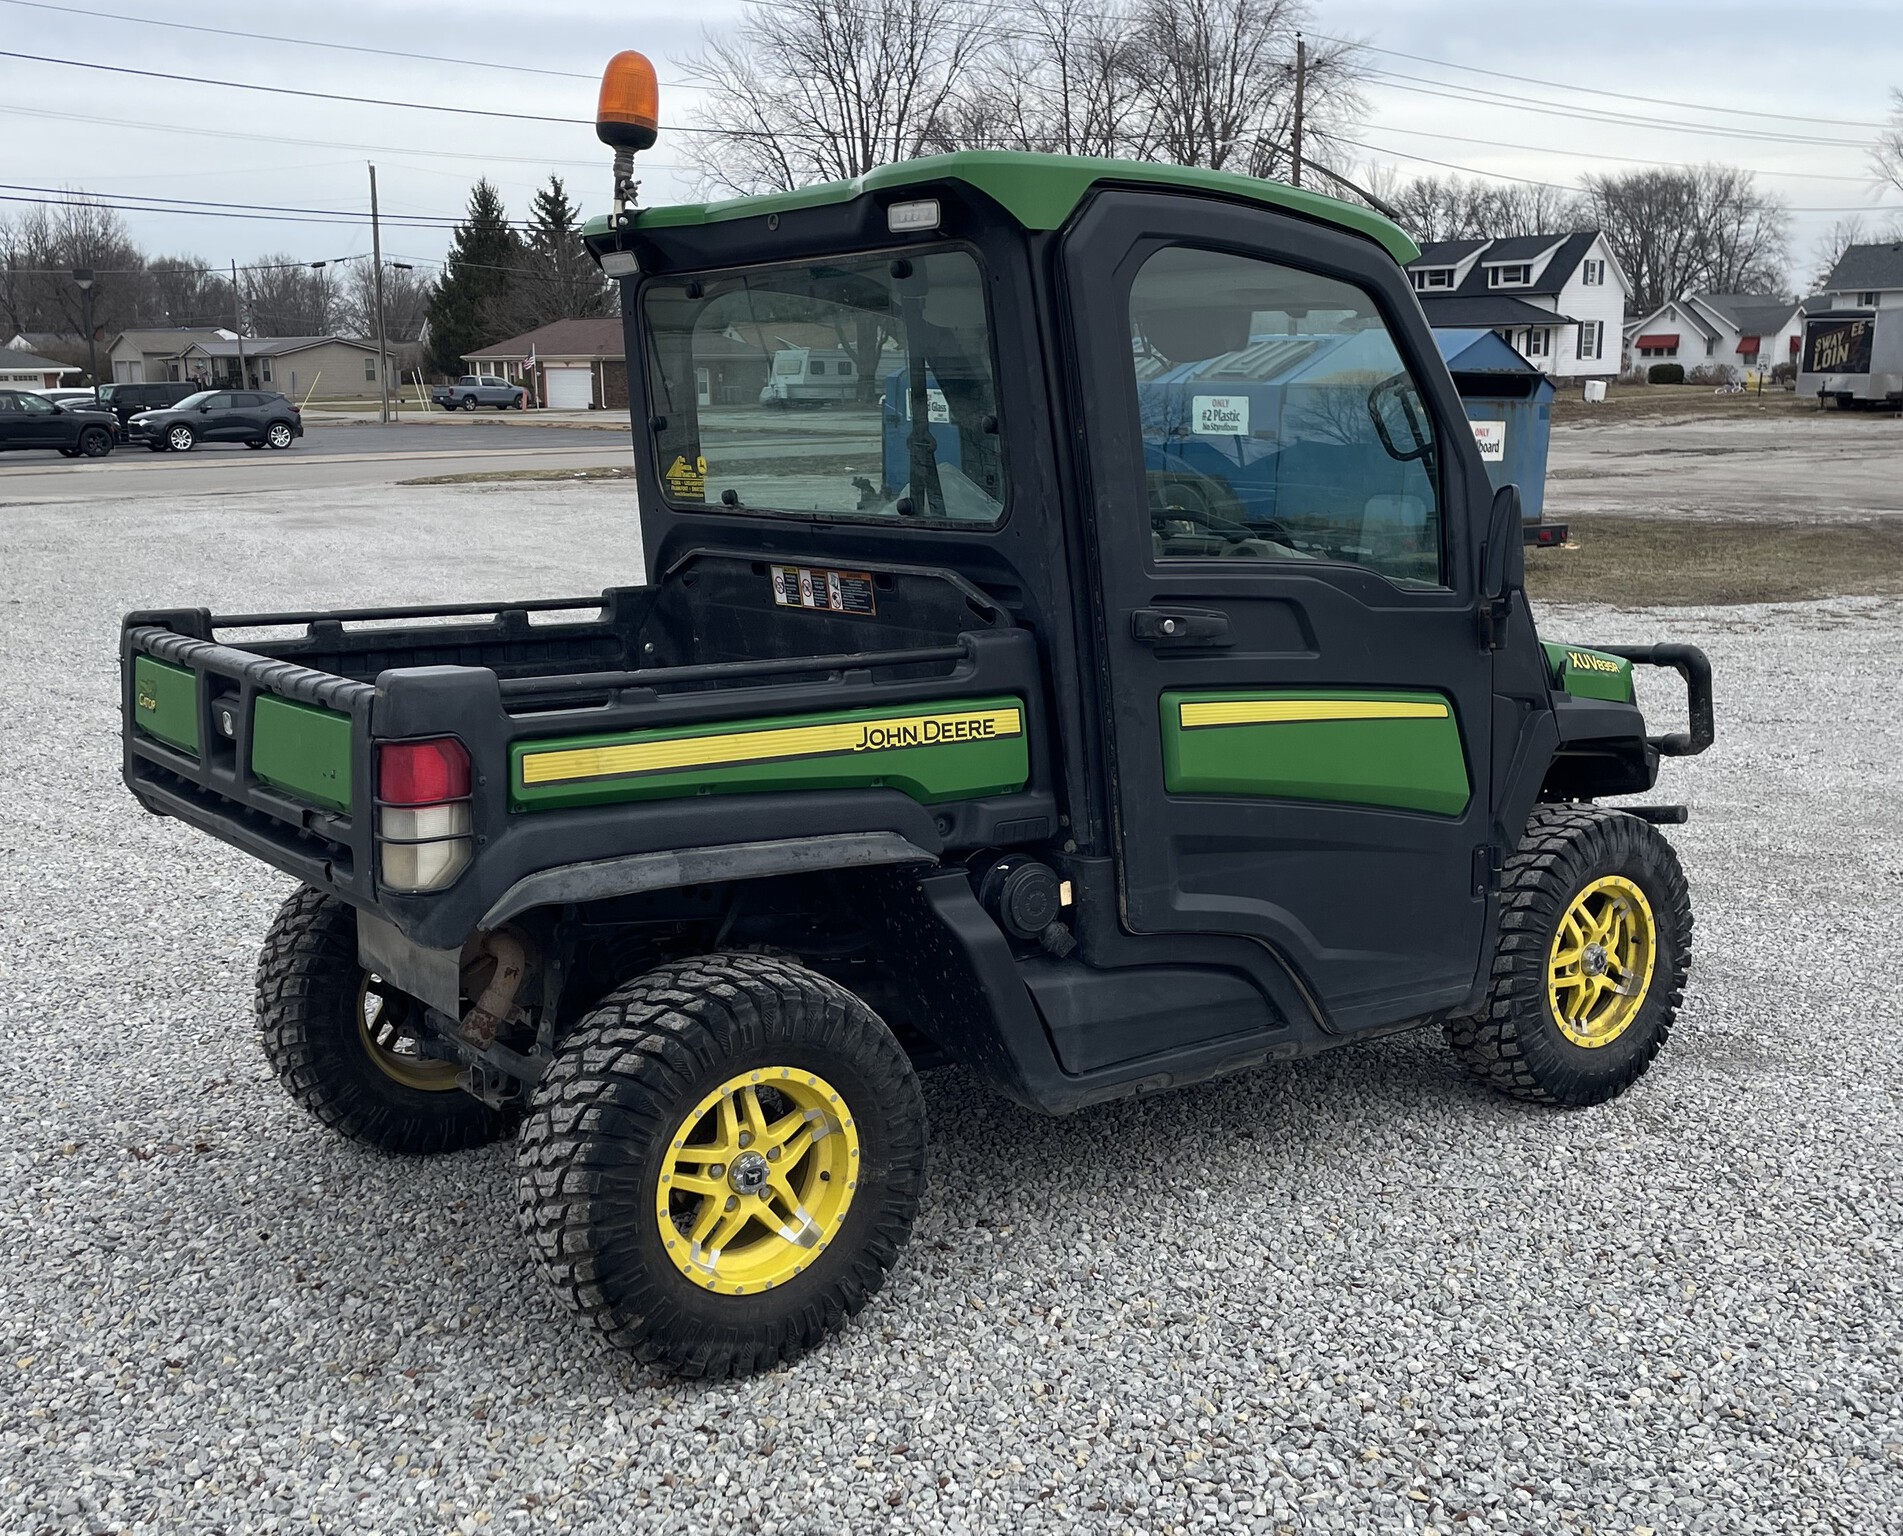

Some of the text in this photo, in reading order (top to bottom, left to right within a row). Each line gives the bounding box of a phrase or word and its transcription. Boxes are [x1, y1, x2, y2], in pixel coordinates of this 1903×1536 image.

[1814, 331, 1844, 353] SWAY
[1813, 342, 1850, 372] LOIN
[1211, 398, 1230, 408] ONLY
[1213, 408, 1241, 422] Plastic
[1475, 427, 1490, 438] ONLY
[854, 718, 996, 750] JOHN DEERE
